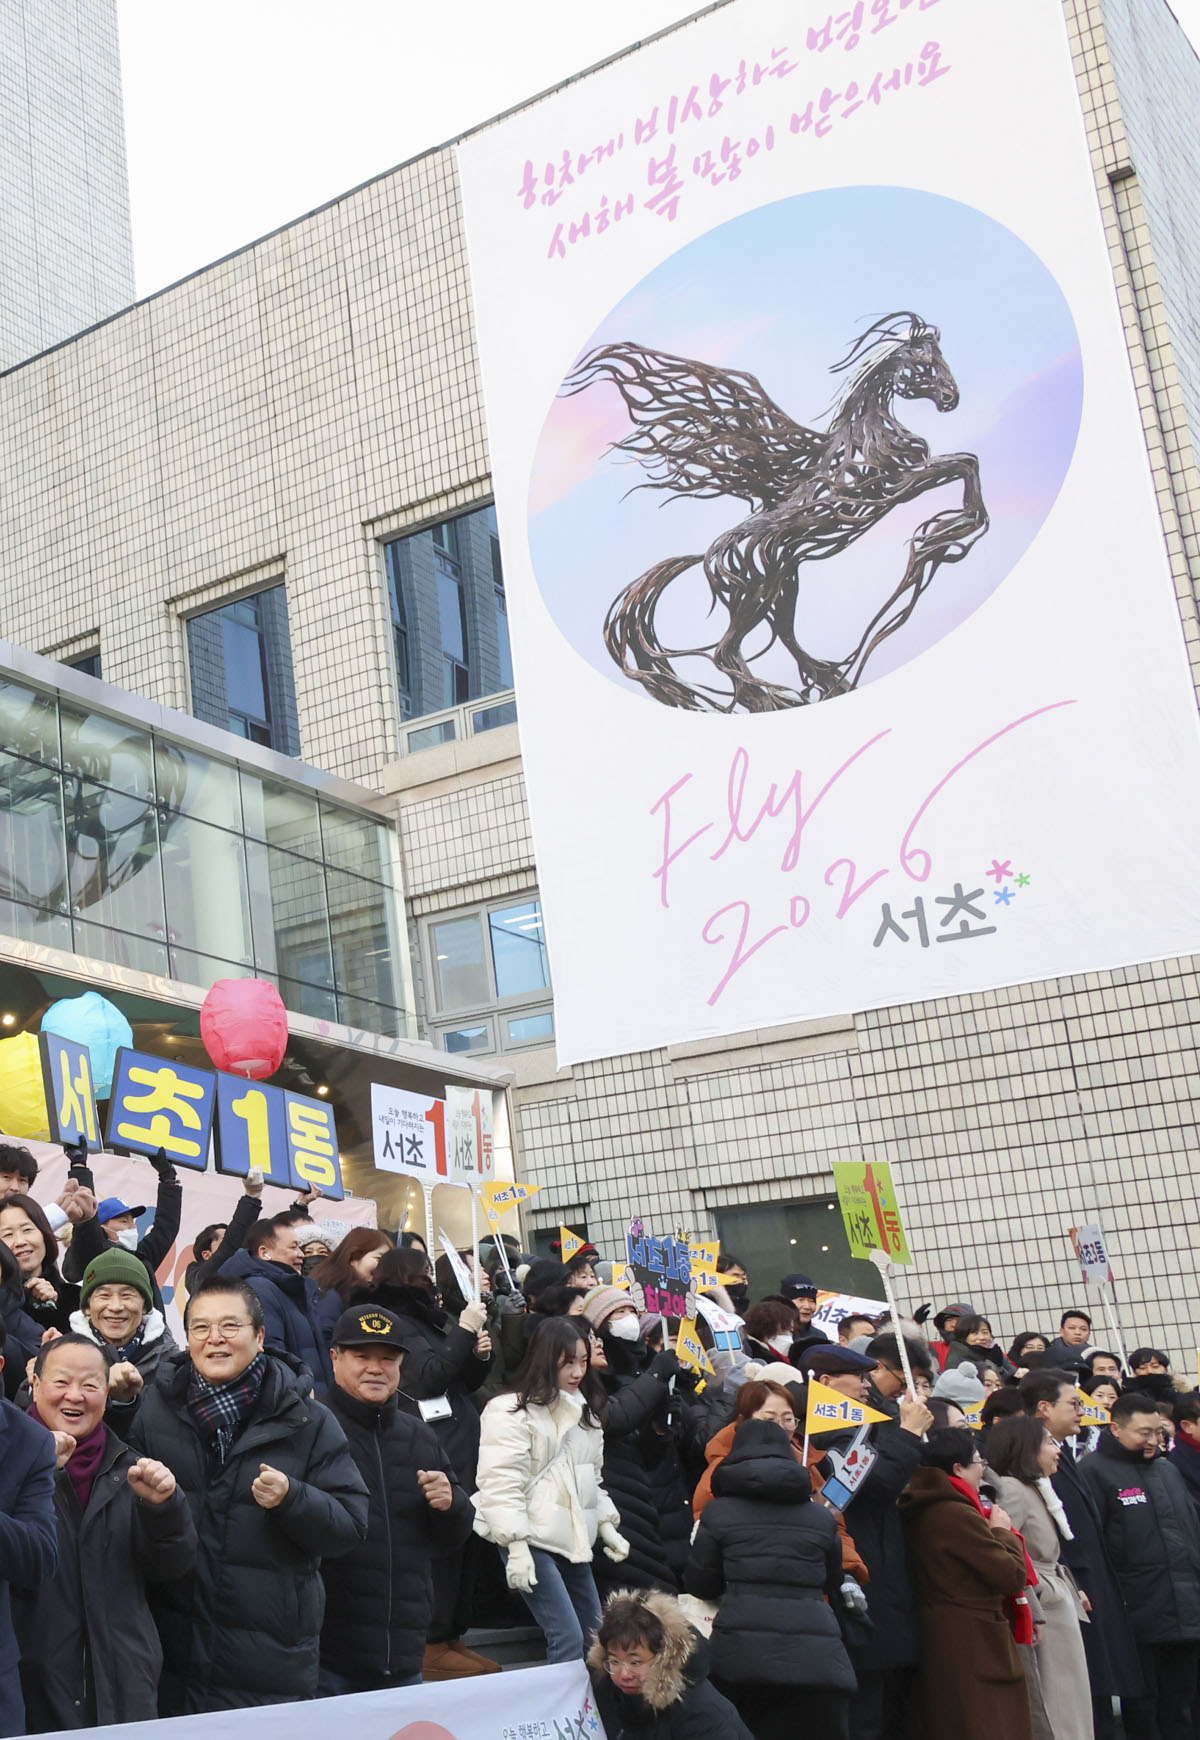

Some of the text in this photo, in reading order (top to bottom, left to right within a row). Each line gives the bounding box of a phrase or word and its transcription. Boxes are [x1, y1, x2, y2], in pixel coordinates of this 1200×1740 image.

[517, 0, 942, 209] 힘차게 비상하는 병오
[547, 41, 952, 260] 새해 복 많이 받으세요
[650, 728, 893, 908] Fly
[701, 699, 1078, 1006] 2026
[873, 883, 998, 948] 서초
[59, 1049, 337, 1187] 서초1동
[383, 1100, 449, 1176] 서초1
[388, 1106, 425, 1123] 오늘 행복하고
[493, 1185, 528, 1203] 서초1동
[627, 1232, 693, 1285] 서초1동
[683, 1337, 707, 1368] 서초1동
[814, 1401, 863, 1422] 서초1동
[841, 1465, 852, 1477] I
